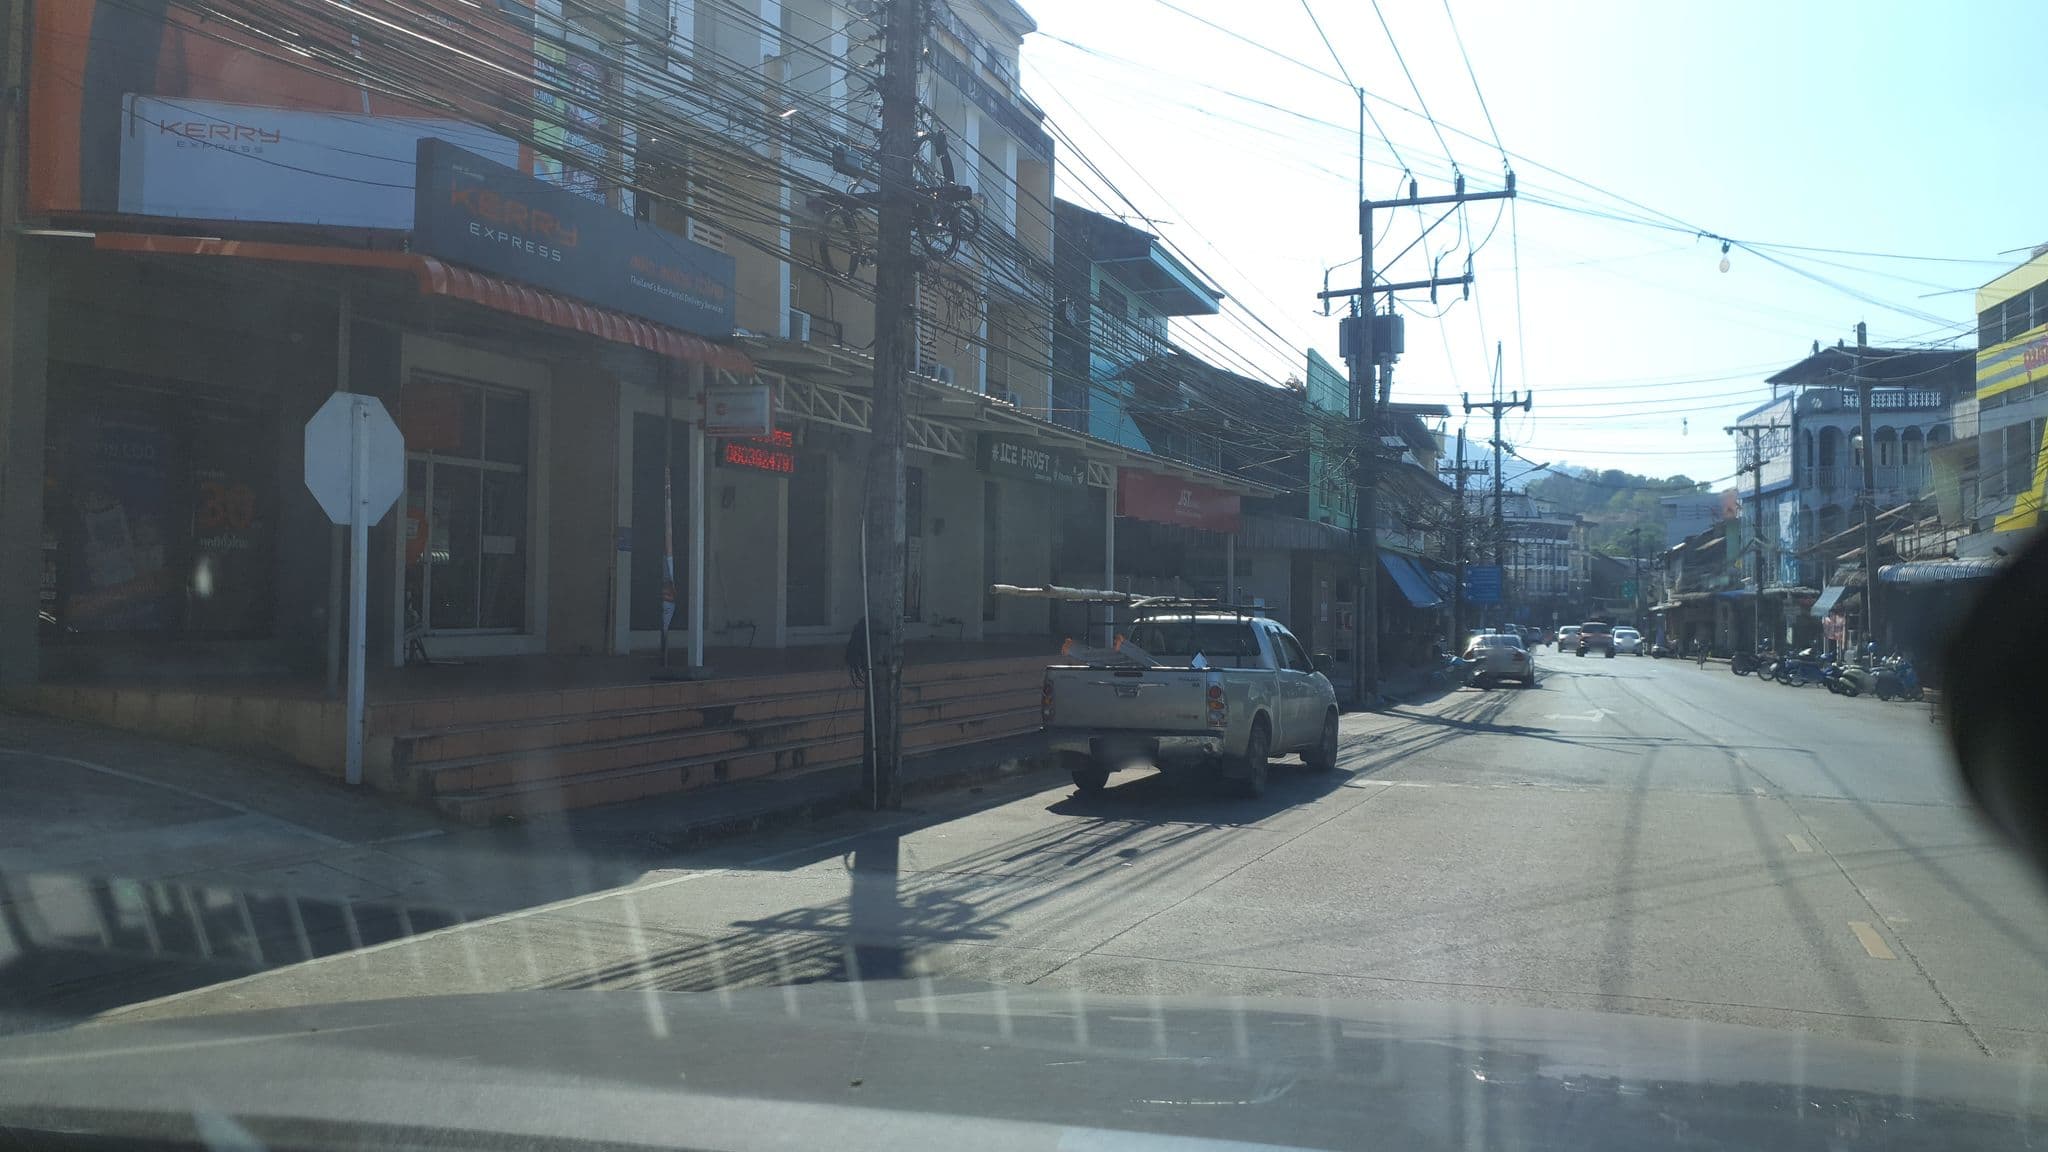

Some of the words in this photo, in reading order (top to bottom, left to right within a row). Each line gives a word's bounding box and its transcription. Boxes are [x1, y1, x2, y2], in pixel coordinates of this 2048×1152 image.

[160, 119, 281, 145] KERRY
[450, 177, 578, 249] KERRY
[468, 222, 562, 263] EXPRESS
[999, 442, 1018, 466] ICE
[1020, 447, 1051, 473] FROST
